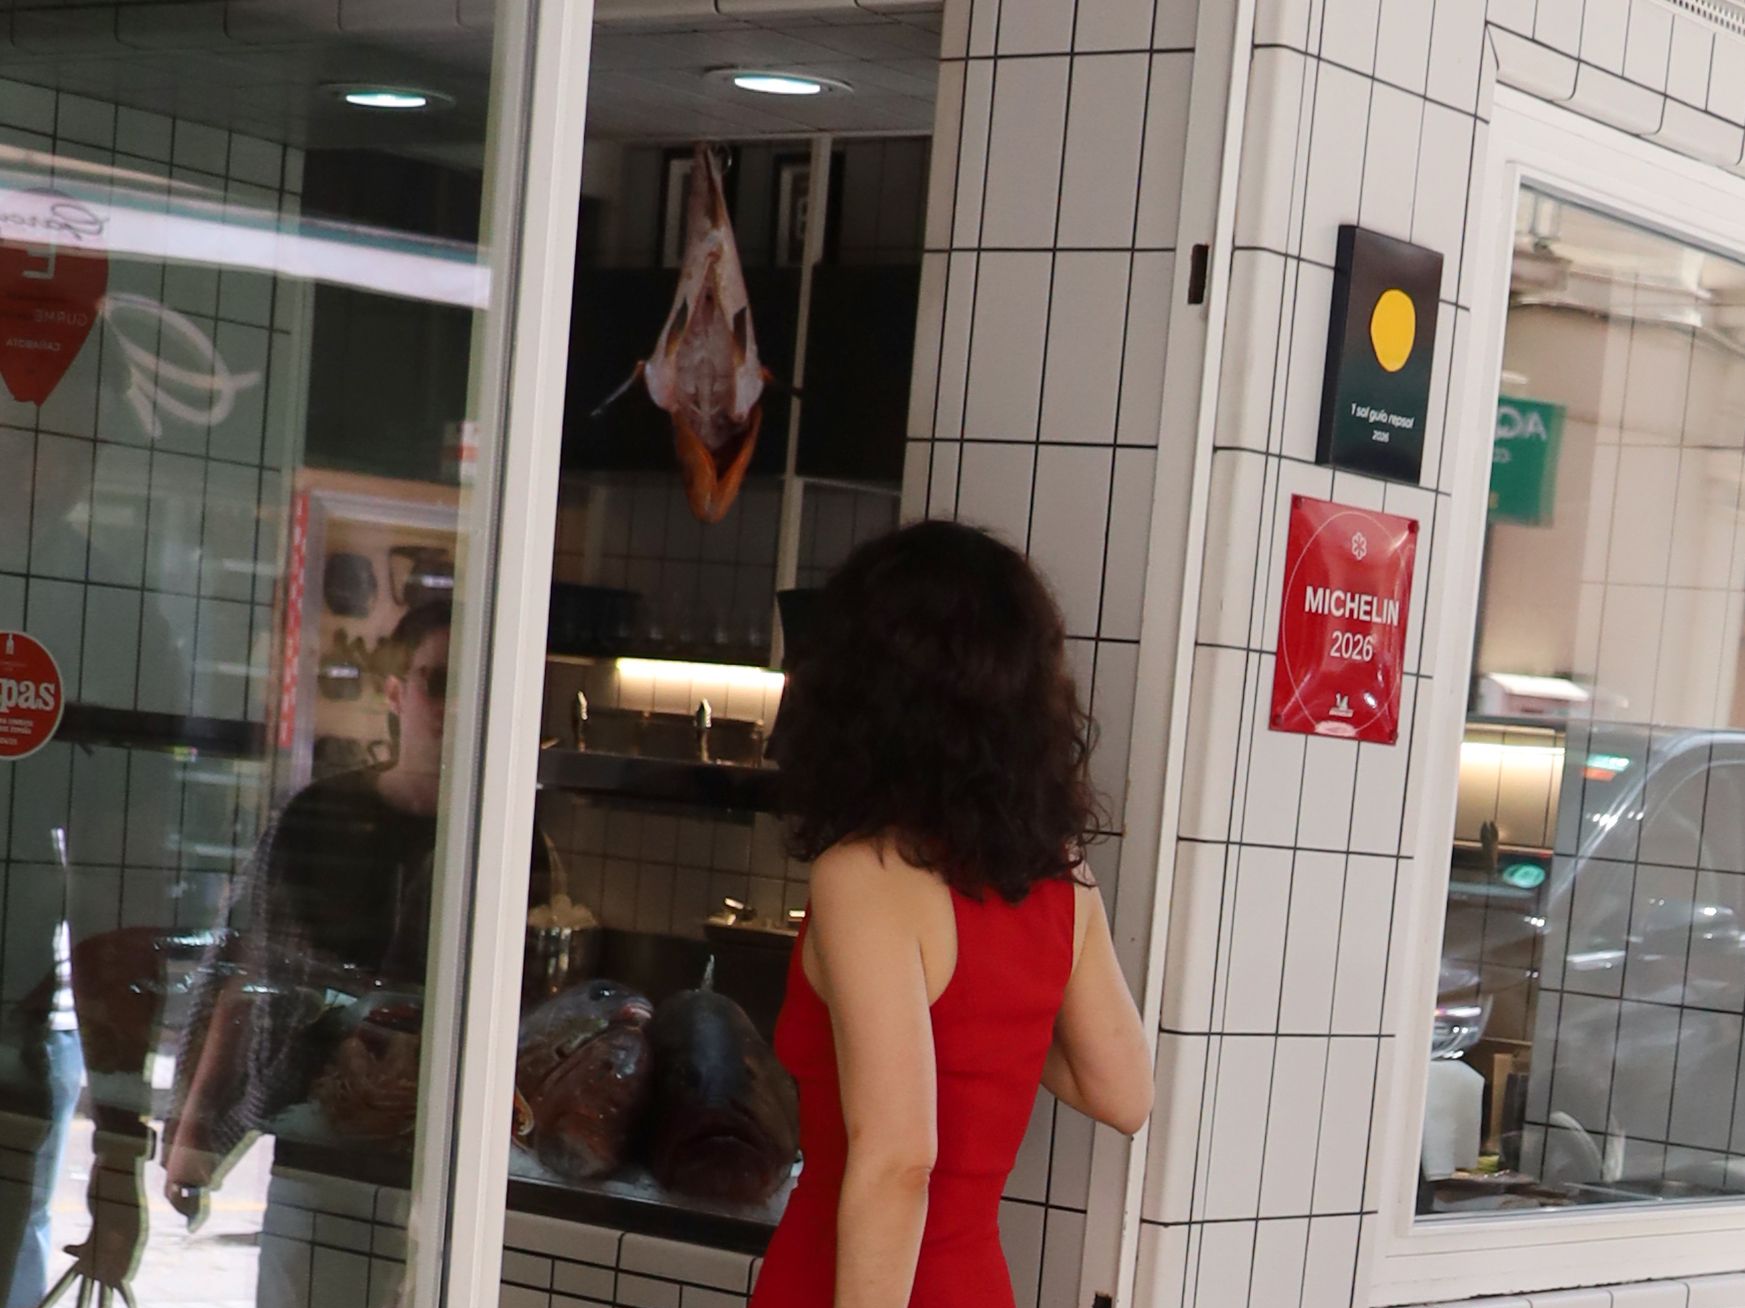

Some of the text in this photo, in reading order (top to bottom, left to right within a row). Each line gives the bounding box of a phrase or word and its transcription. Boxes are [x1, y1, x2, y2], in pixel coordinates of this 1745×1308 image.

[1356, 406, 1371, 418] sol
[1388, 413, 1415, 429] repsol
[1304, 585, 1399, 626] MICHELIN
[1329, 630, 1374, 662] 2026
[0, 677, 56, 713] pas
